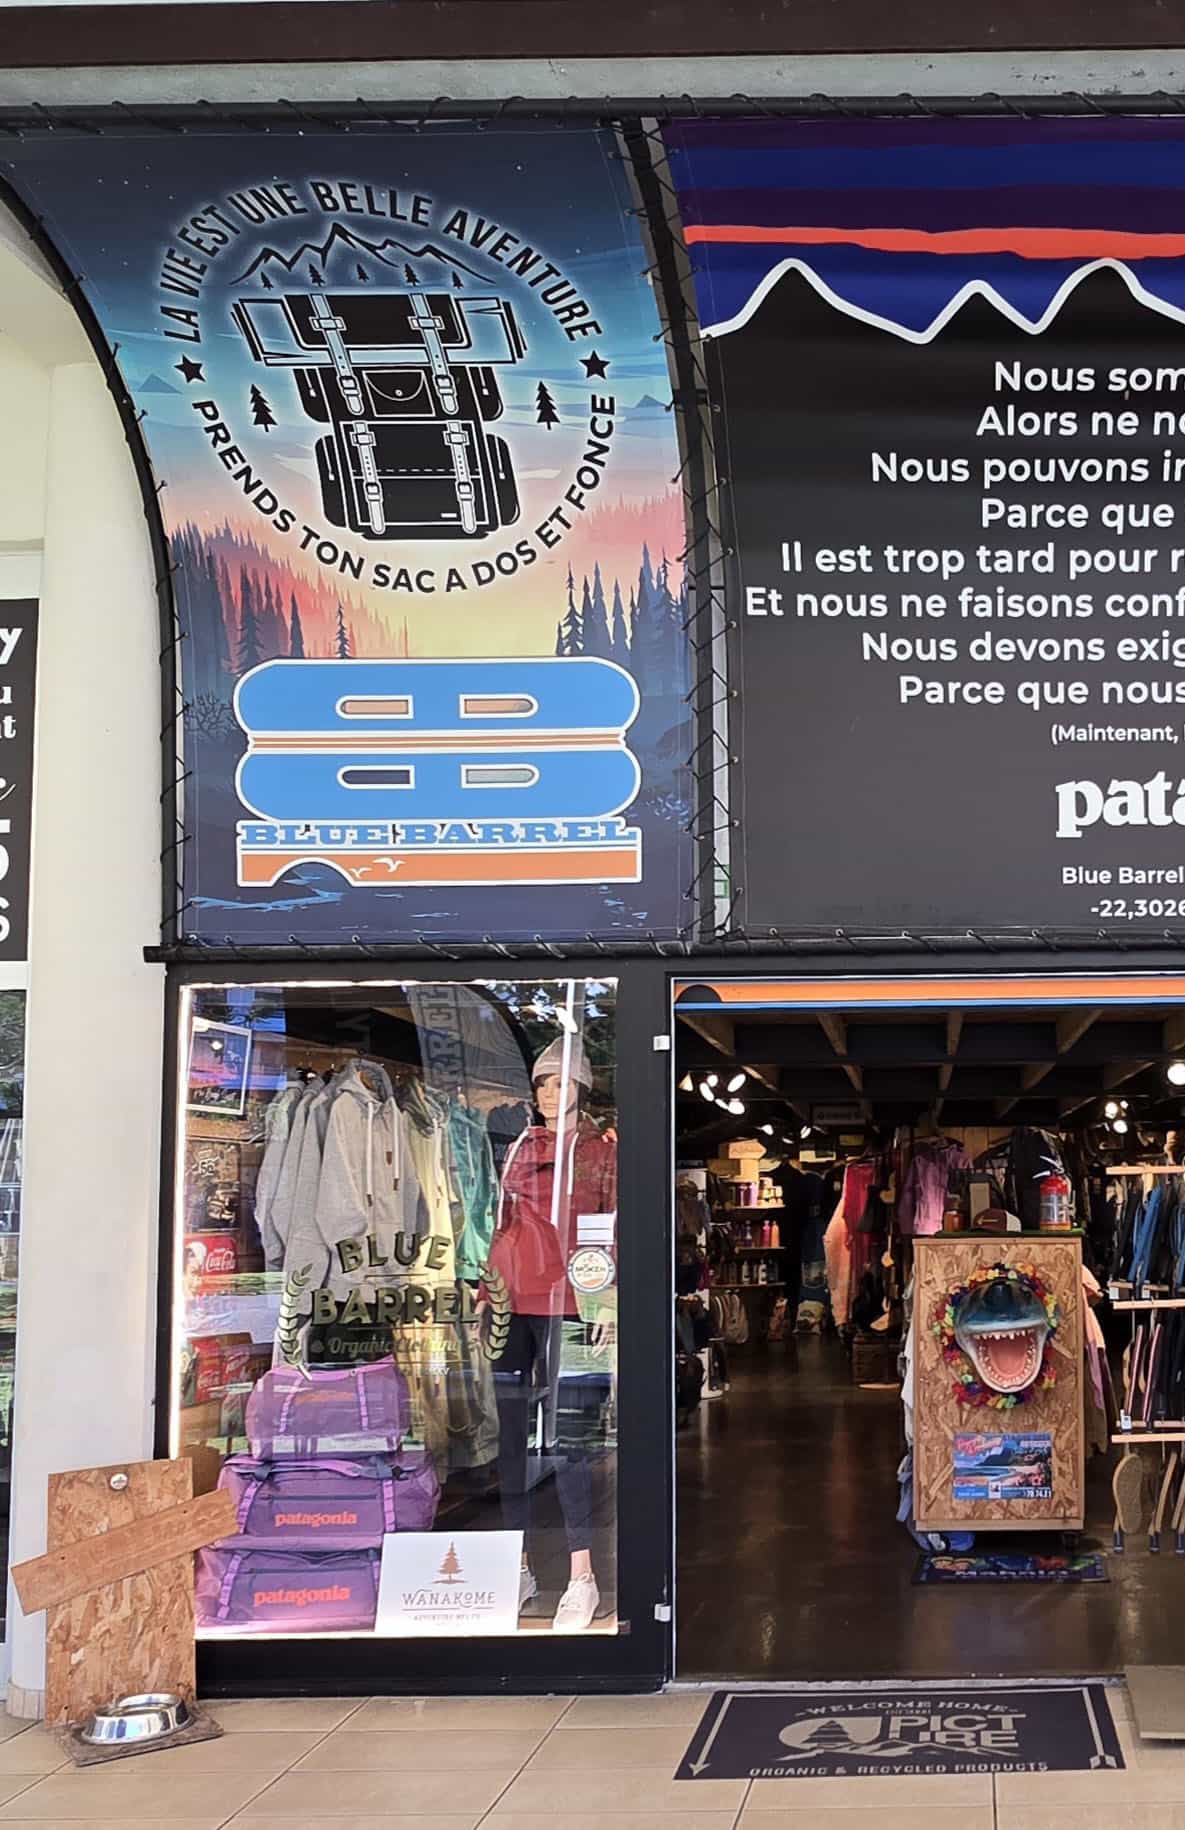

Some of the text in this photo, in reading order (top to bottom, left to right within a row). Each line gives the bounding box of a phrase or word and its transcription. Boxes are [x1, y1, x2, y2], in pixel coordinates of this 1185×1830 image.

[160, 181, 602, 343] LA VIE EST UNE BELLE AVENTURE
[996, 362, 1095, 391] Nous
[976, 405, 1077, 435] Alors
[1092, 412, 1138, 435] ne
[872, 453, 969, 481] Nous
[984, 459, 1148, 489] pouvons
[192, 394, 615, 592] PRENDS TON SAC A DOS ET FONCE
[982, 499, 1088, 528] Parce
[1102, 504, 1174, 534] que
[782, 541, 801, 571] Il
[816, 545, 872, 572] est
[884, 546, 964, 580] trop
[976, 542, 1054, 573] tard
[1070, 550, 1158, 580] pour
[746, 587, 784, 616] Et
[797, 594, 887, 617] nous
[901, 595, 946, 617] ne
[958, 586, 1093, 617] faisons
[863, 633, 957, 661] Nous
[969, 631, 1105, 661] devons
[900, 676, 1005, 704] Parce
[1018, 682, 1088, 710] que
[1051, 723, 1178, 745] (Maintenant,
[241, 822, 637, 845] BLUE BARREL
[1062, 866, 1112, 884] Blue
[1119, 866, 1184, 884] Barrel
[336, 1231, 451, 1273] BLUE
[311, 1284, 481, 1327] BARREL
[328, 1334, 391, 1357] Organic
[274, 1511, 358, 1528] patagonia
[253, 1585, 351, 1608] patagonia
[402, 1588, 496, 1608] WANAKOME
[805, 1701, 932, 1715] WELCOME
[937, 1701, 1009, 1713] HOME
[889, 1713, 1027, 1731] PICT
[749, 1762, 1049, 1777] ORGANIC & RECYCLED PRODUCTS
